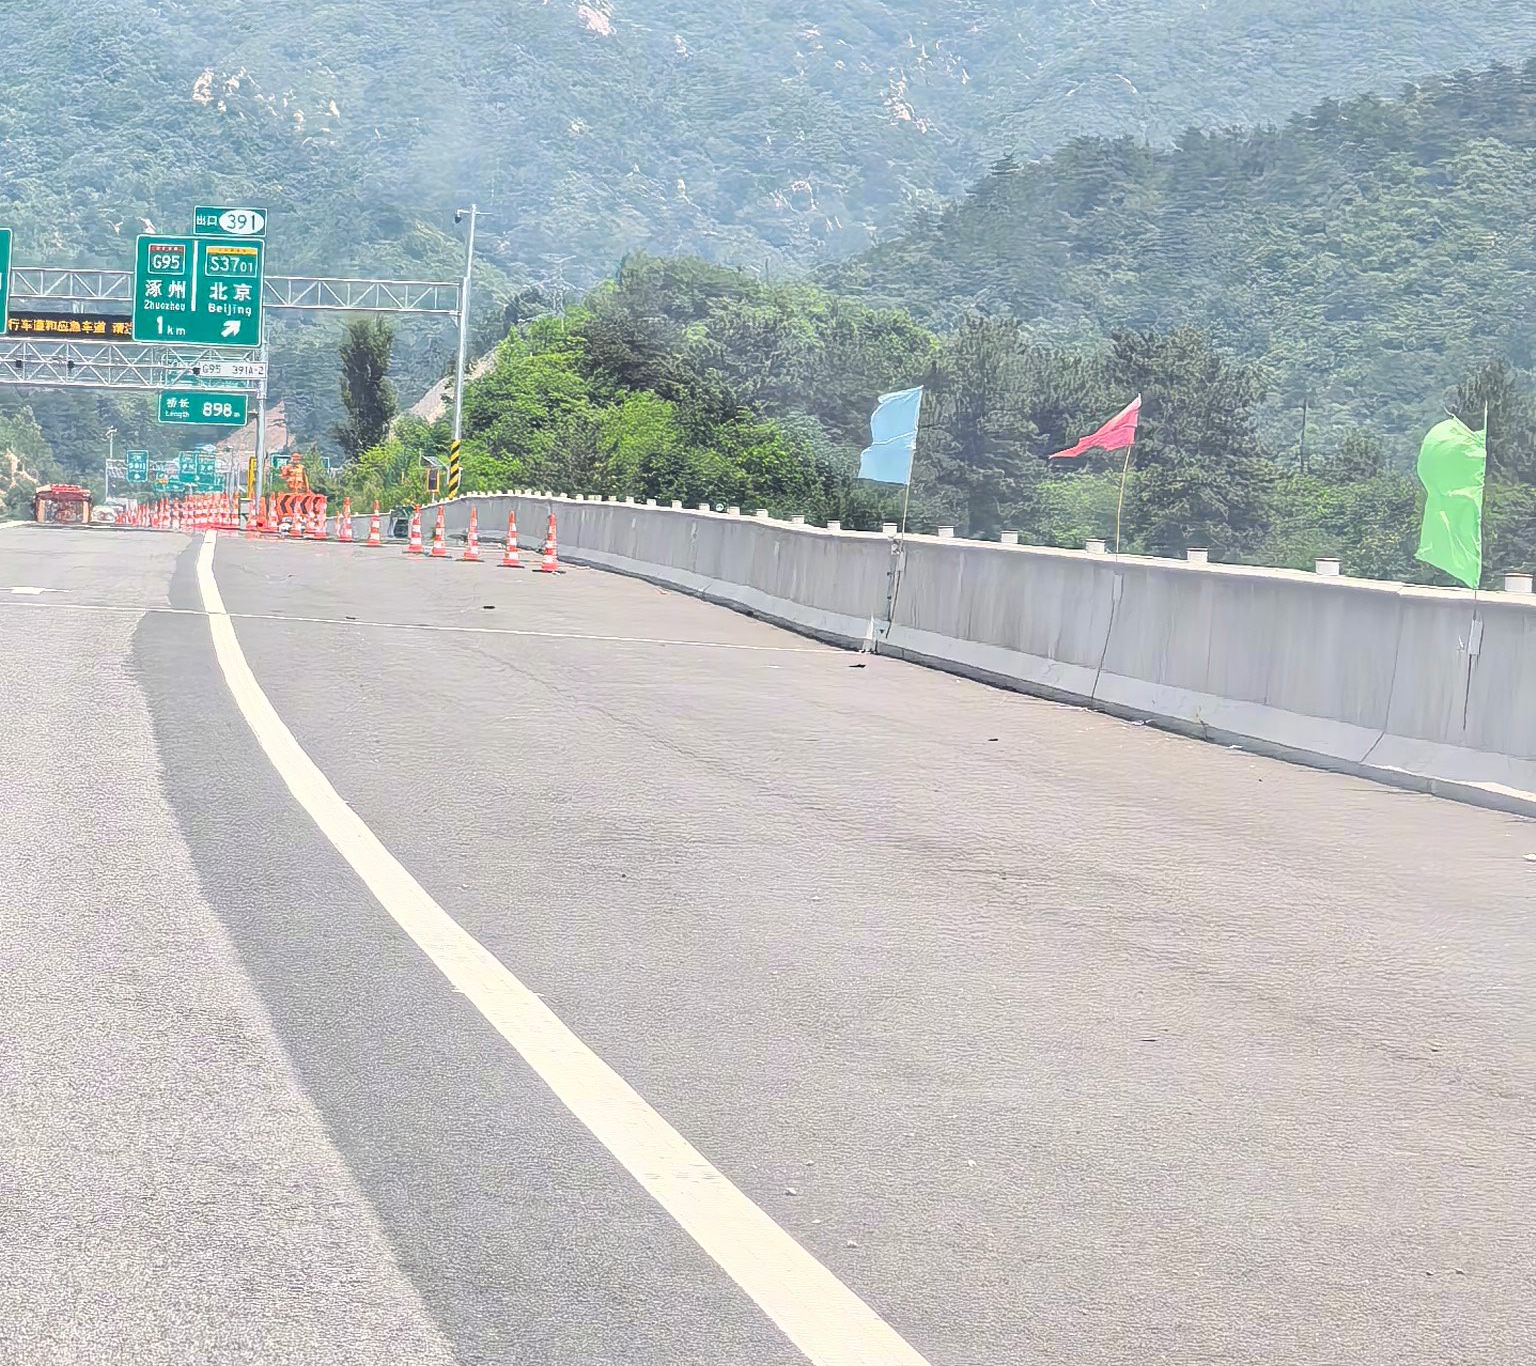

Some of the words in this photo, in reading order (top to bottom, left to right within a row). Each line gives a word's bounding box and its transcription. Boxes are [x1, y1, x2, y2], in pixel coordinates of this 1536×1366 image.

[196, 215, 218, 227] 出口
[227, 214, 256, 230] 391
[152, 254, 180, 269] G95
[210, 256, 253, 272] S3701
[145, 279, 186, 298] 涿州
[209, 281, 252, 301] 北京
[144, 299, 185, 311] Zhuozhou
[207, 302, 252, 317] Beijing
[167, 324, 186, 335] km
[202, 365, 221, 374] G95
[202, 402, 232, 417] 898
